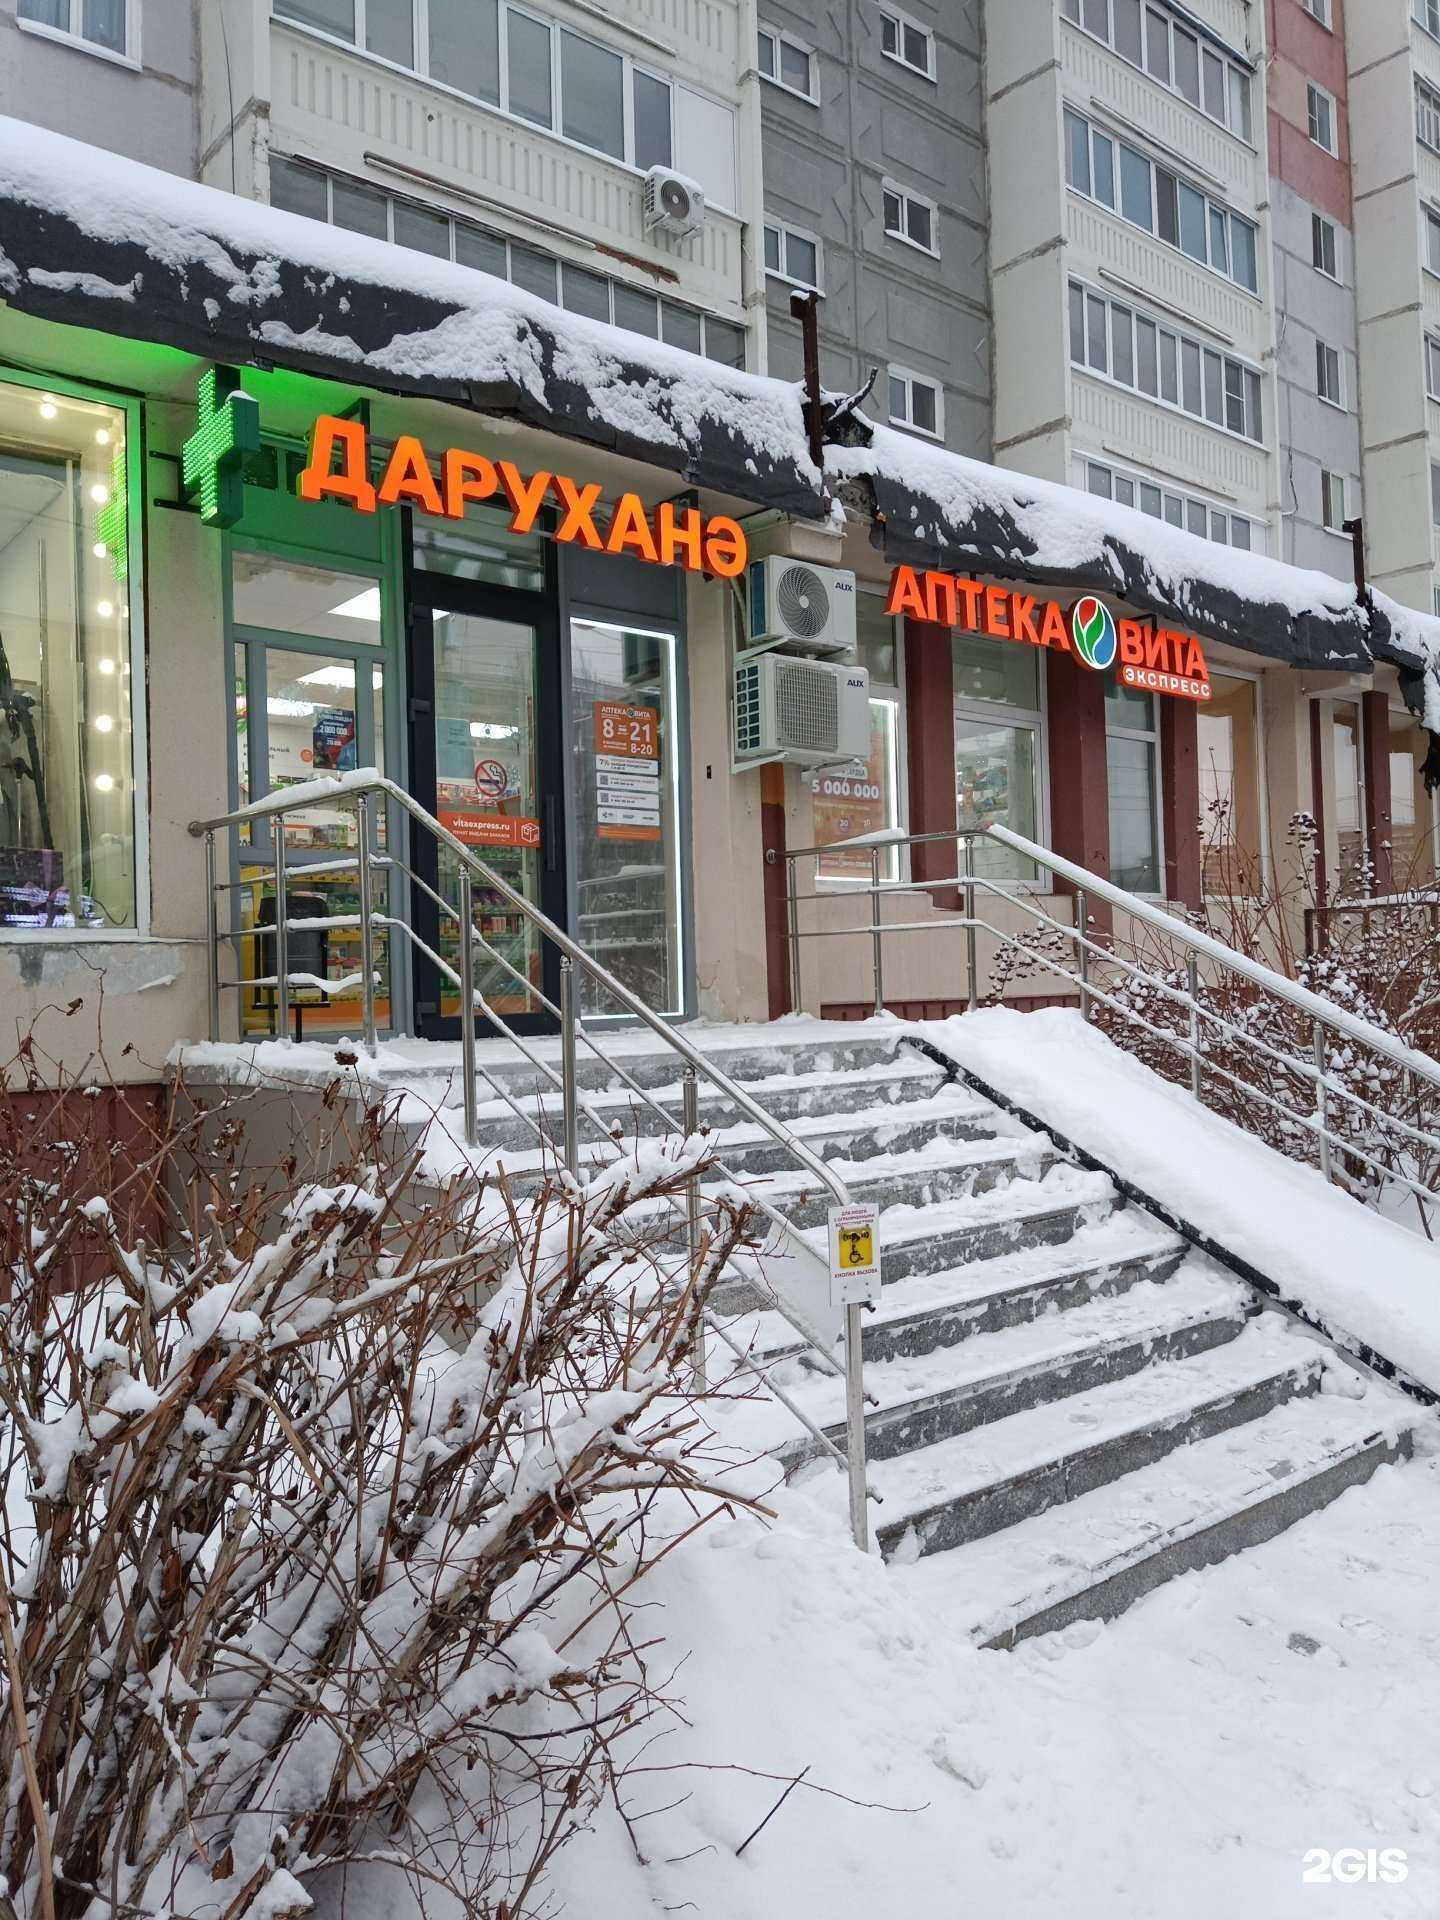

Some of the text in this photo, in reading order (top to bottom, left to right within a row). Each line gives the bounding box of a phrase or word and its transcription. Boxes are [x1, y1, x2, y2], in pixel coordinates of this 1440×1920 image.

[298, 414, 748, 577] ДАРУХАНӘ
[835, 582, 853, 591] AUX
[887, 564, 1208, 680] АПТЕКА ВИТА
[847, 679, 864, 688] AUX
[1124, 667, 1211, 698] ЭКСПРЕСС
[601, 706, 626, 715] АПТЕКА
[602, 718, 615, 739] 8
[630, 721, 651, 743] 21
[630, 743, 653, 755] 8-20
[812, 779, 879, 799] 5 000 000
[452, 818, 511, 831] vitaexpress.ru
